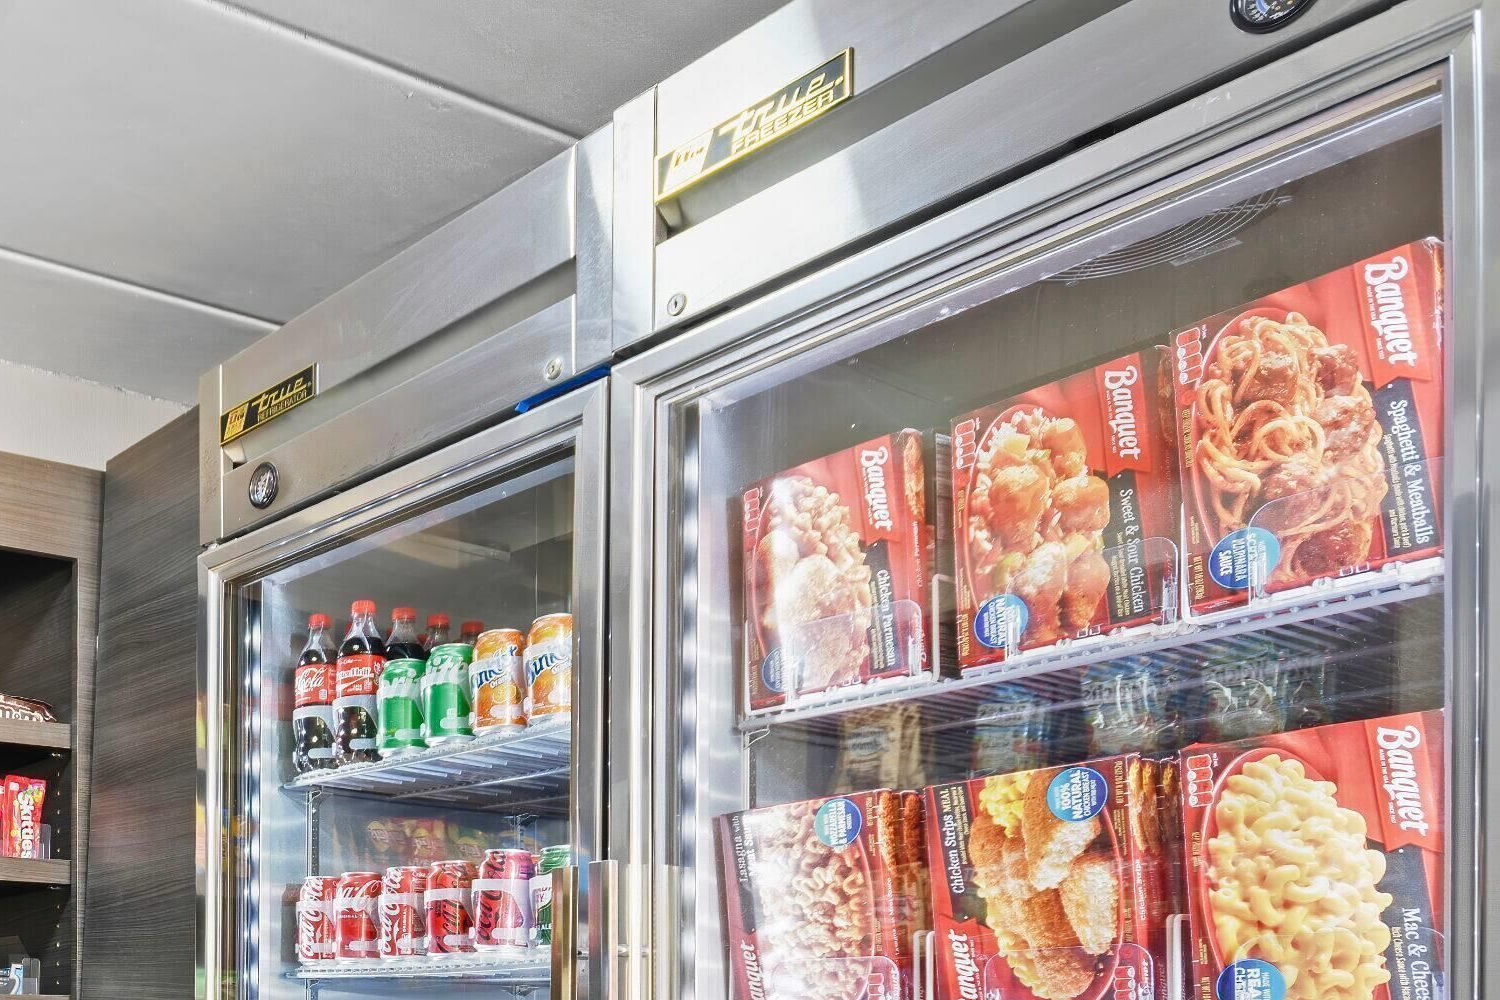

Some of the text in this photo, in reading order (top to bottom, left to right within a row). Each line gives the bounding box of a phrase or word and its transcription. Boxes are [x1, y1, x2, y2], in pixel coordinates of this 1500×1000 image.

[732, 89, 834, 156] FREEZER
[1365, 256, 1419, 366] Banquet
[257, 389, 307, 422] REFRIGERATOR
[1104, 365, 1142, 461] Banquet
[860, 446, 893, 531] Banquet
[1387, 399, 1433, 545] Spaghetti & Meatballs
[1119, 488, 1146, 613] Sweet & Sour Chicken
[1219, 550, 1233, 576] SAUCE
[876, 569, 893, 612] Chicken
[881, 613, 896, 667] Parmesan
[1060, 782, 1072, 811] 100%
[1070, 770, 1084, 819] NATURAL
[1081, 771, 1092, 817] CHICKEN BREAST
[1376, 725, 1429, 837] Banquet
[16, 788, 36, 859] Skittles
[939, 788, 965, 894] Chicken Strips MEAL
[731, 815, 749, 884] Lasagna with
[1401, 907, 1422, 940] Mac
[1393, 938, 1404, 957] Cheese
[1395, 957, 1406, 973] Sauce
[1407, 943, 1428, 958] &
[10, 963, 22, 995] 5
[1261, 972, 1270, 988] MADE
[1398, 973, 1409, 986] with
